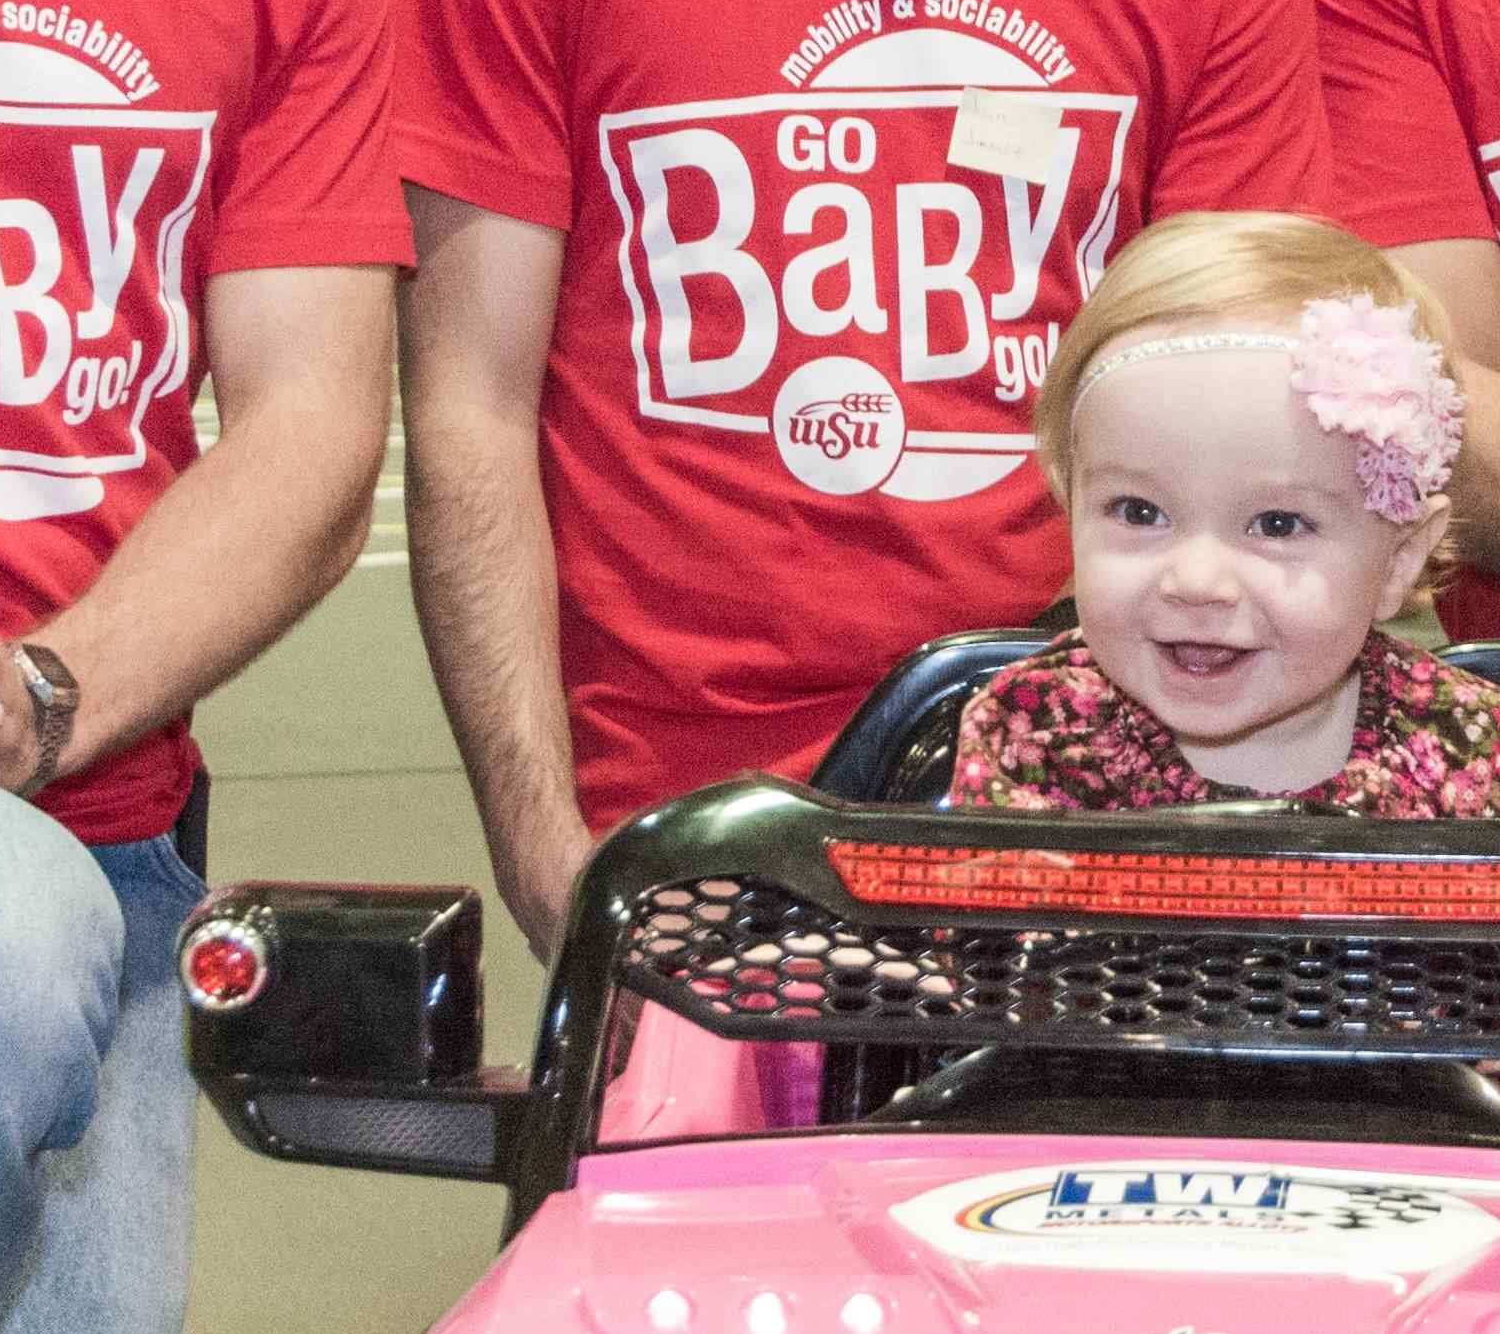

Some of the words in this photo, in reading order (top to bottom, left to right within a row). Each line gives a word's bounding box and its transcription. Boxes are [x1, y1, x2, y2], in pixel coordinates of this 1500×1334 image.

[1, 1, 160, 102] sociability
[776, 115, 877, 174] GO
[62, 340, 142, 425] go!
